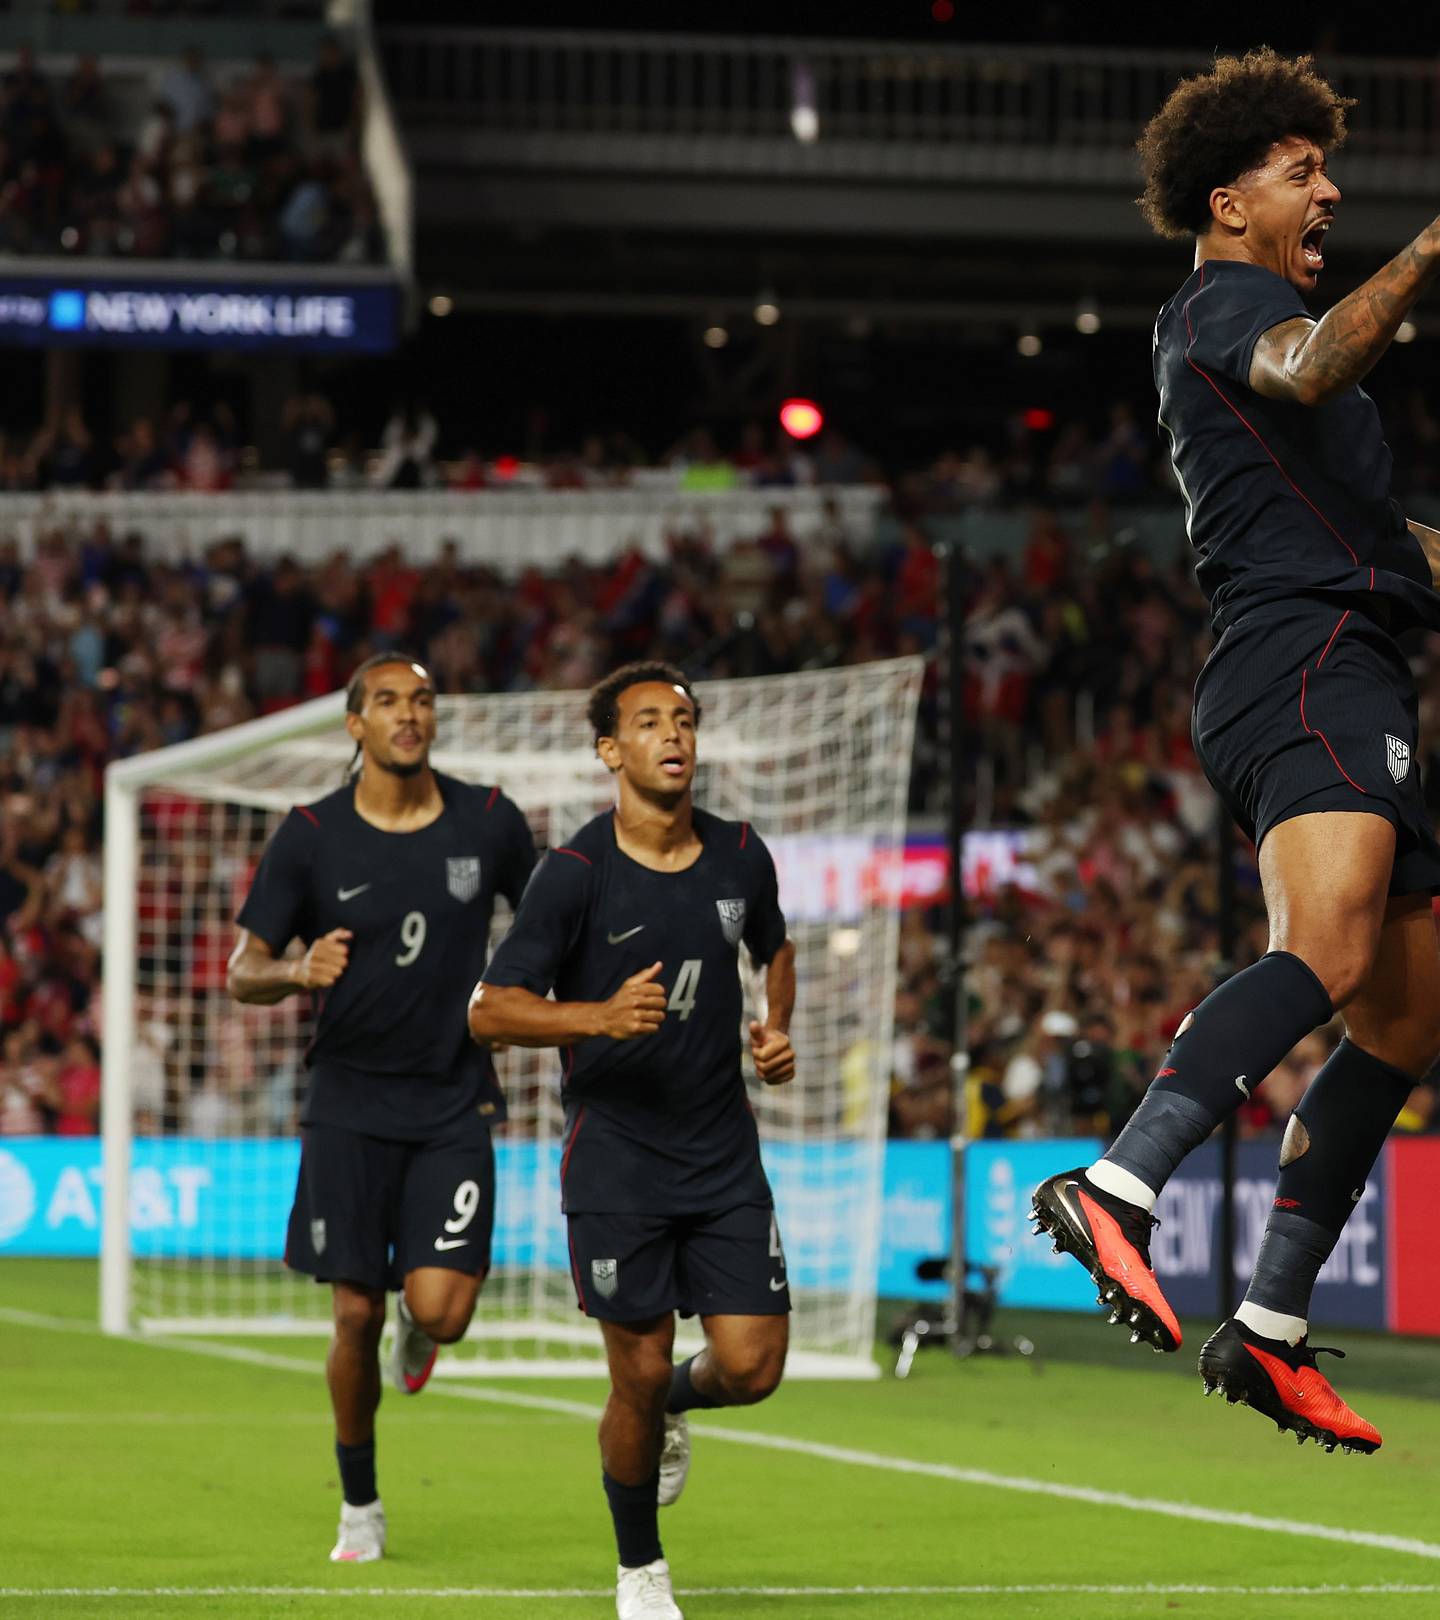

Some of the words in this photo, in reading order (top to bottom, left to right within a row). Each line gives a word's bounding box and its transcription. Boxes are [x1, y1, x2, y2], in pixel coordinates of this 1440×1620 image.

[88, 291, 172, 333] NEW
[170, 292, 274, 336] YORK
[273, 295, 356, 338] LIFE
[1388, 736, 1408, 758] USA
[718, 900, 745, 921] USA
[395, 910, 427, 968] 9
[667, 959, 703, 1021] 4
[46, 1166, 212, 1229] A&T
[444, 1179, 480, 1234] 9
